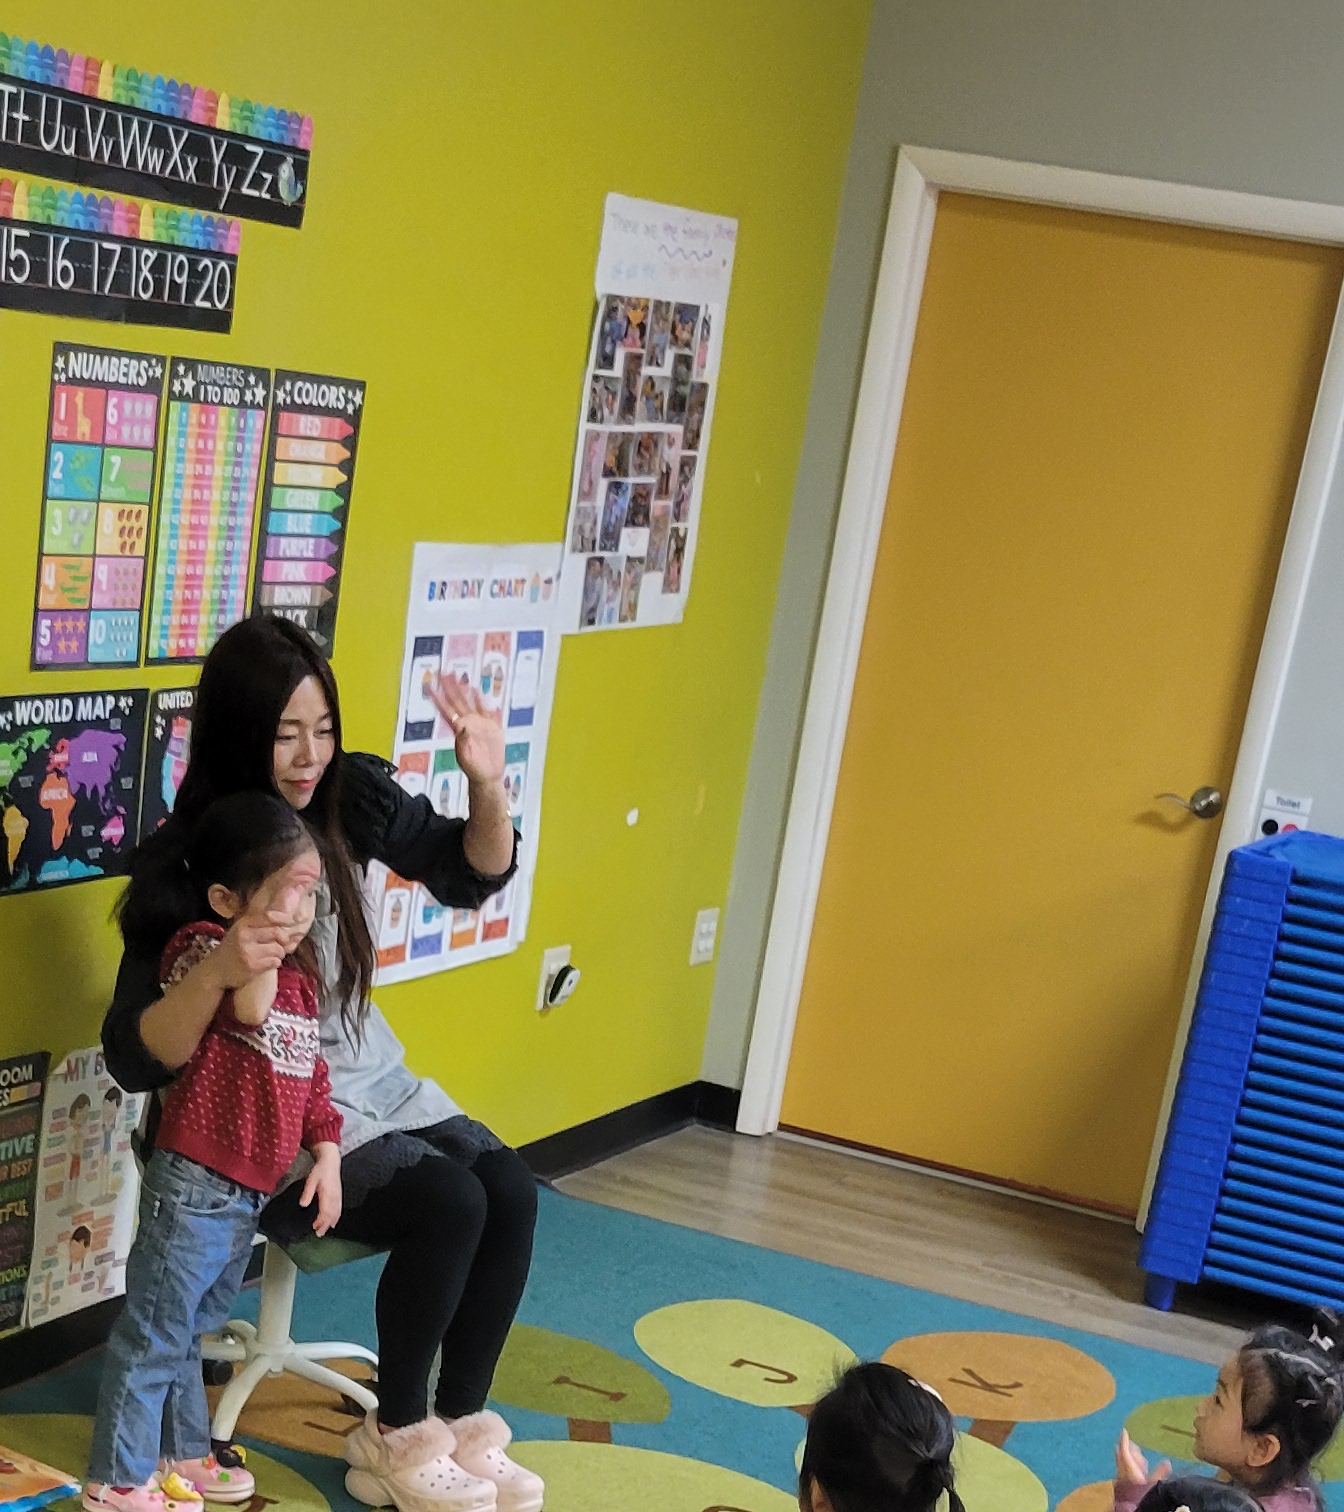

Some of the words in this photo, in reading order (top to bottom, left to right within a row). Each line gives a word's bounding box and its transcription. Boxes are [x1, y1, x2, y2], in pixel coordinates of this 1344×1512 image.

[0, 227, 31, 284] 15
[47, 222, 75, 291] 16
[92, 240, 121, 296] 17
[130, 245, 158, 301] 18
[163, 252, 189, 305] 19
[193, 257, 231, 311] 20
[68, 351, 148, 387] NUMBERS
[197, 363, 245, 388] NUMBERS
[60, 392, 67, 420] 1
[207, 385, 221, 403] TO
[223, 387, 240, 405] 100
[293, 381, 346, 409] COLORS
[107, 397, 119, 425] 6
[52, 451, 64, 480] 2
[110, 455, 122, 482] 7
[51, 508, 63, 536] 3
[43, 562, 56, 591] 4
[97, 564, 109, 591] 9
[428, 578, 484, 601] BIRTHDAY
[490, 578, 526, 598] CHART
[39, 619, 52, 647] 5
[89, 619, 107, 645] 10
[14, 698, 73, 726] WORLD
[76, 696, 116, 721] MAP
[158, 691, 193, 711] UNITED
[64, 1055, 91, 1084] MY
[729, 1357, 799, 1385] J
[949, 1366, 1024, 1398] K
